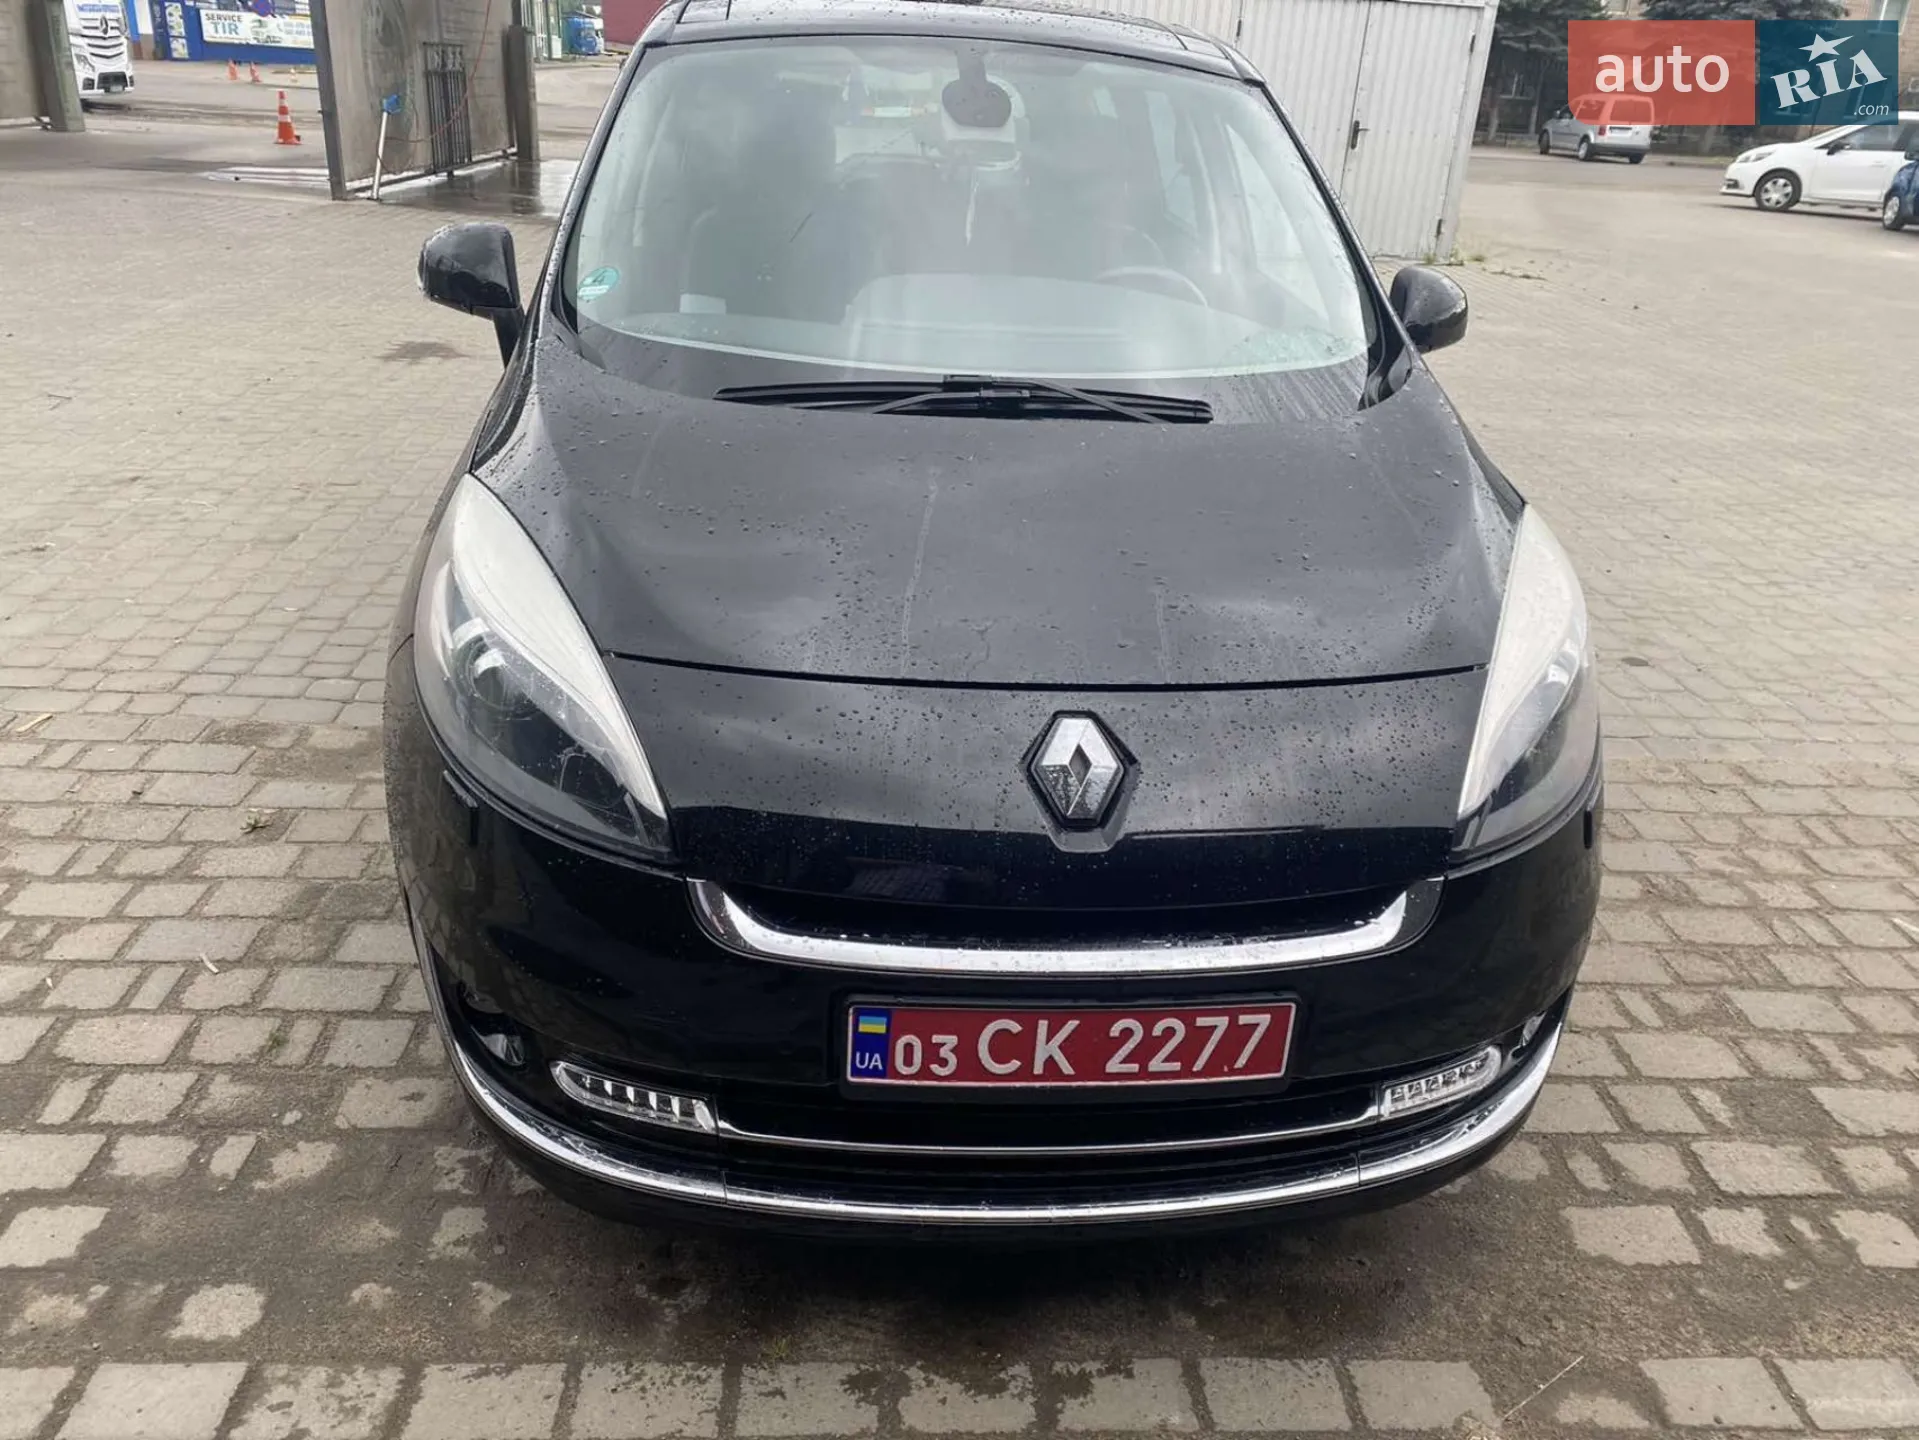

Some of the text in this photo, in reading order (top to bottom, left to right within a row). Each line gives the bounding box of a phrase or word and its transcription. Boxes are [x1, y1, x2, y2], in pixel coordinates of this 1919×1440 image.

[205, 13, 242, 22] SERVICE
[211, 22, 239, 35] TIR
[895, 1013, 1272, 1076] 03 CK 2277
[855, 1051, 883, 1070] UA
